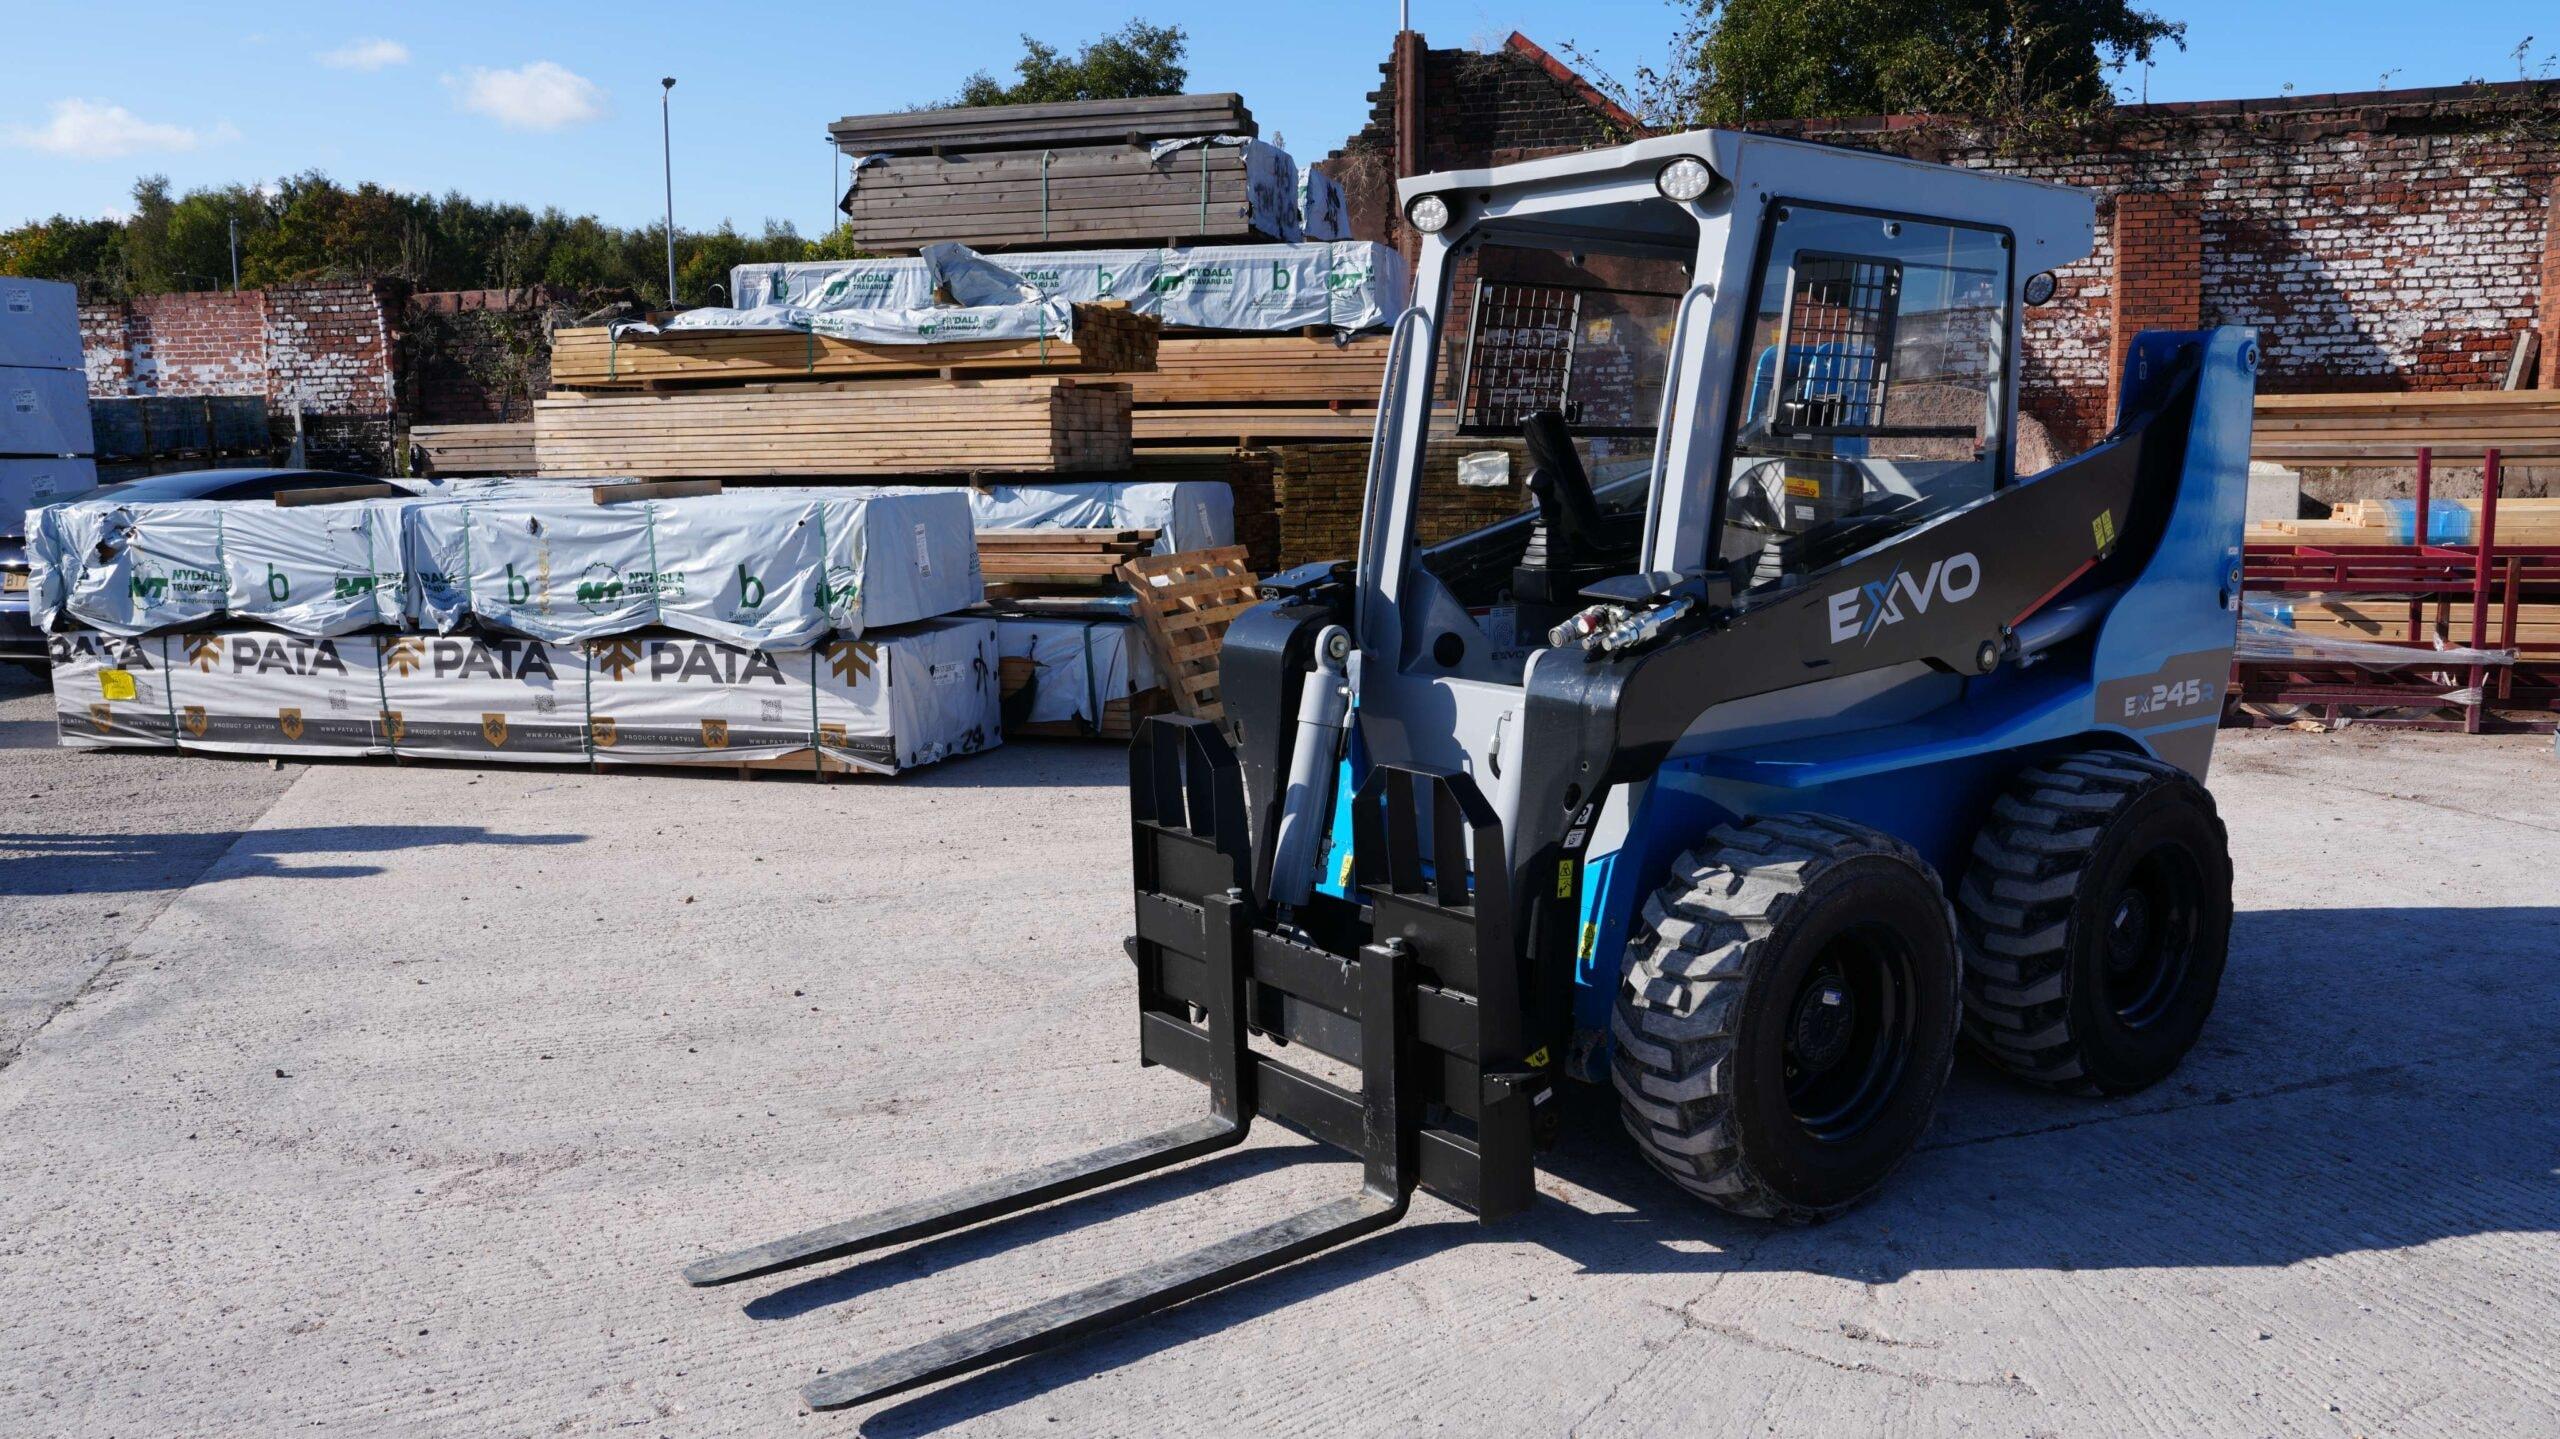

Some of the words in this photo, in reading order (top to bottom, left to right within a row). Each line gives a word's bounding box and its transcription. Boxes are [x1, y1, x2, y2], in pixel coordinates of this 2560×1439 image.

[1097, 264, 1114, 292] b
[1187, 267, 1233, 277] NYDALA
[1273, 261, 1291, 290] b
[267, 562, 291, 603] b
[505, 562, 531, 605] b
[738, 563, 766, 609] b
[1827, 551, 1981, 648] EXVO
[232, 637, 350, 677] PATA
[433, 639, 559, 680] PATA
[651, 642, 787, 685] PATA
[410, 728, 442, 736] PRODUCT
